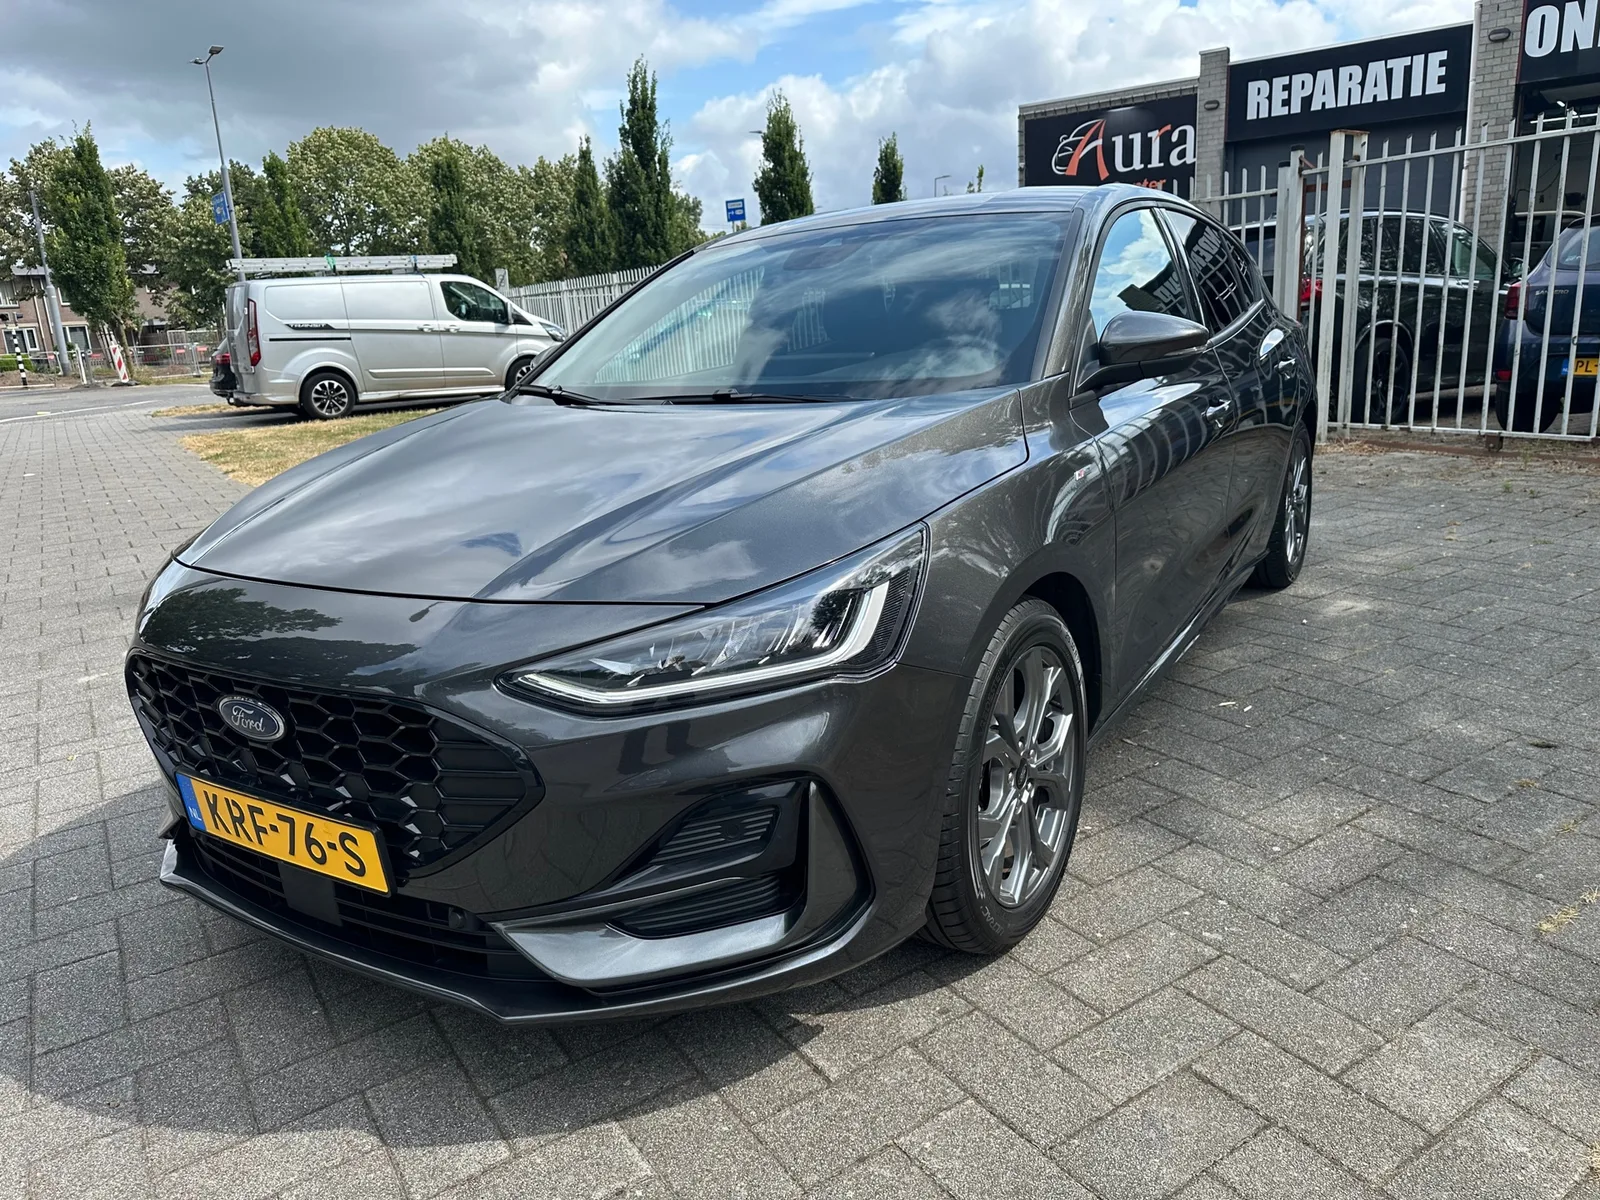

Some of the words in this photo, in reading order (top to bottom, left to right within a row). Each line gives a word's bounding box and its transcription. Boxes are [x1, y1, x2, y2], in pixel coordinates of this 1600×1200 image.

[1524, 0, 1600, 58] ON
[1246, 50, 1448, 121] REPARATIE
[1063, 118, 1197, 181] Aura
[231, 705, 266, 732] Ford
[188, 806, 203, 821] NL
[203, 789, 367, 878] KRF-76-S
